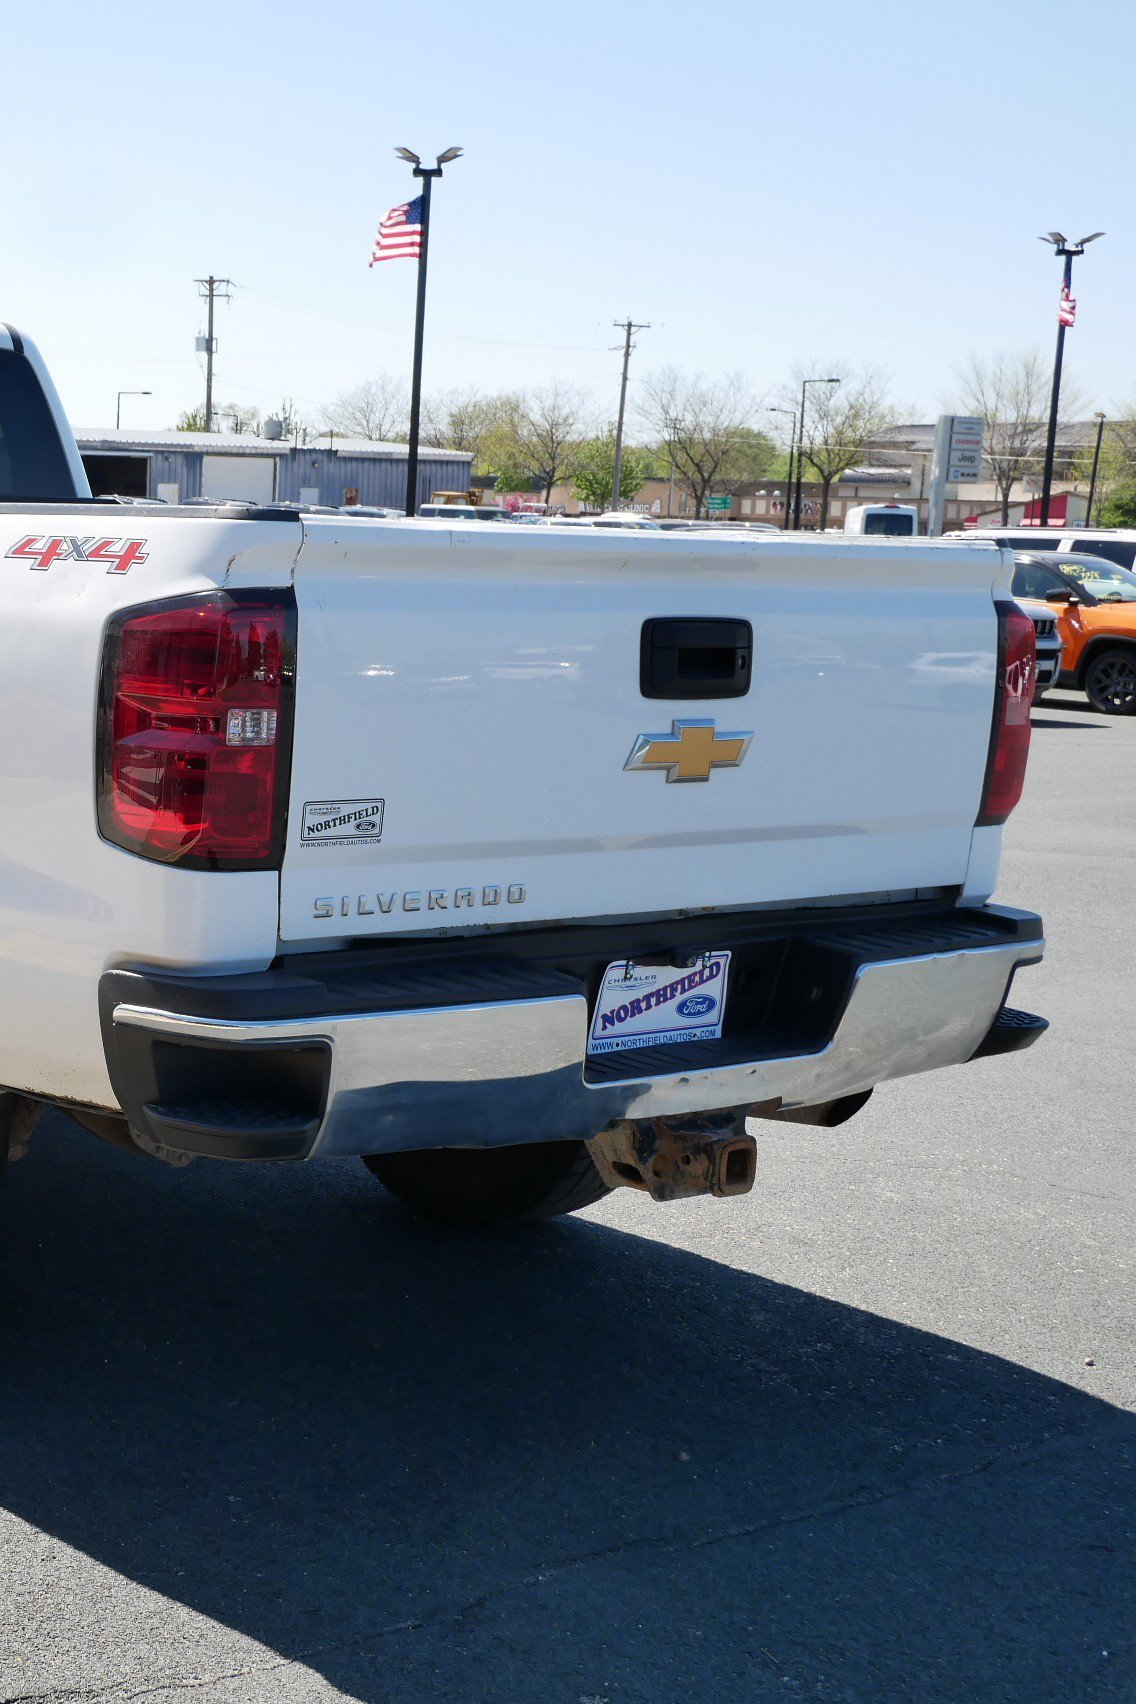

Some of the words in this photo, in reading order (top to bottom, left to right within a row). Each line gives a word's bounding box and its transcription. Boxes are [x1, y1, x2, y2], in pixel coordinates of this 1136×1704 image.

[958, 452, 976, 464] Jeep
[306, 805, 380, 836] NORTHFIELD
[313, 883, 527, 918] SILVERADO
[600, 961, 721, 1032] NORTHFIELD
[683, 998, 708, 1014] Ford
